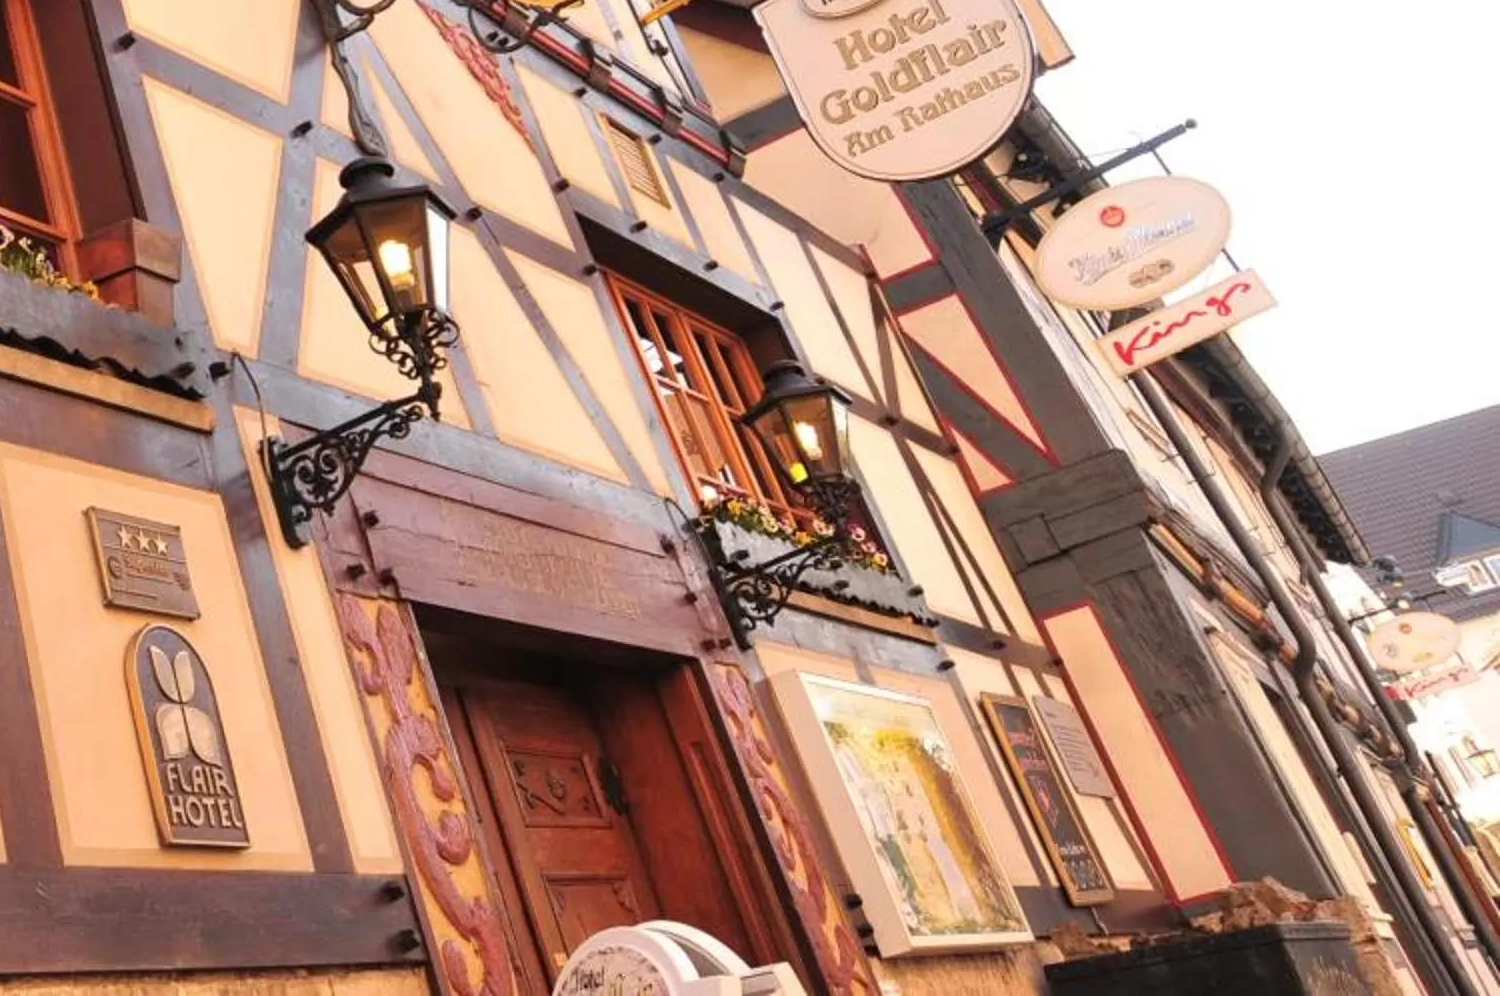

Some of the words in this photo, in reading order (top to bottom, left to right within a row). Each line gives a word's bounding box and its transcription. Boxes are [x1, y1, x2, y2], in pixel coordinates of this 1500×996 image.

[819, 19, 1008, 125] Goldflair
[843, 123, 895, 157] Am
[895, 62, 1021, 134] Rathaus
[167, 763, 234, 797] FLAIR
[168, 796, 243, 829] HOTEL
